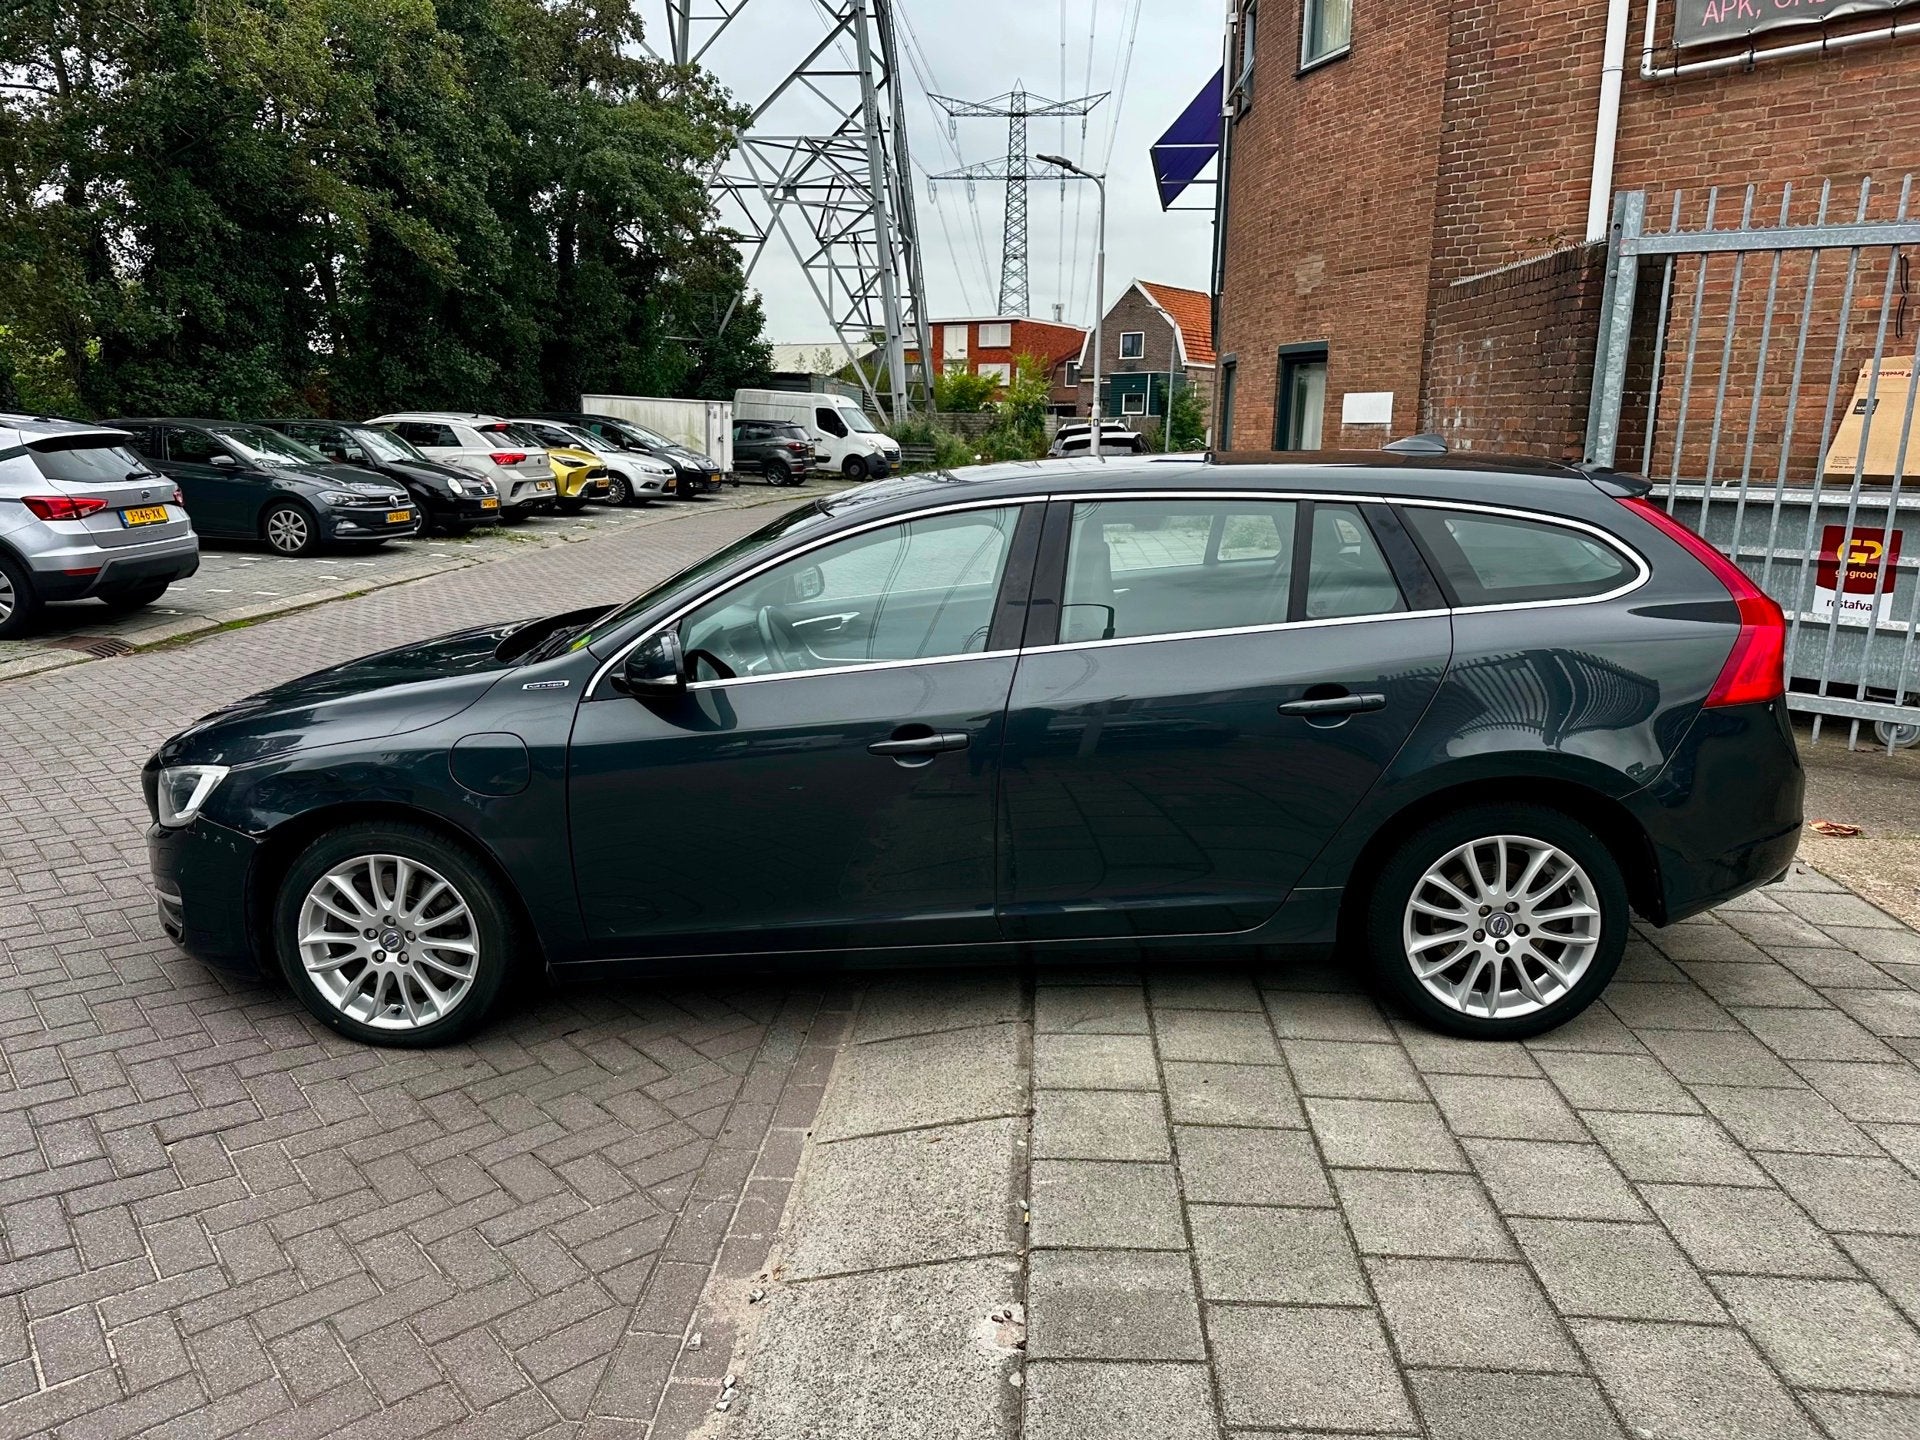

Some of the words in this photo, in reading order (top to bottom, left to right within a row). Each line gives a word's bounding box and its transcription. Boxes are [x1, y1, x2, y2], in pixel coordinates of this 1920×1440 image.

[1702, 0, 1762, 26] APK,
[130, 507, 164, 522] J-146-XK
[1849, 570, 1878, 579] groot
